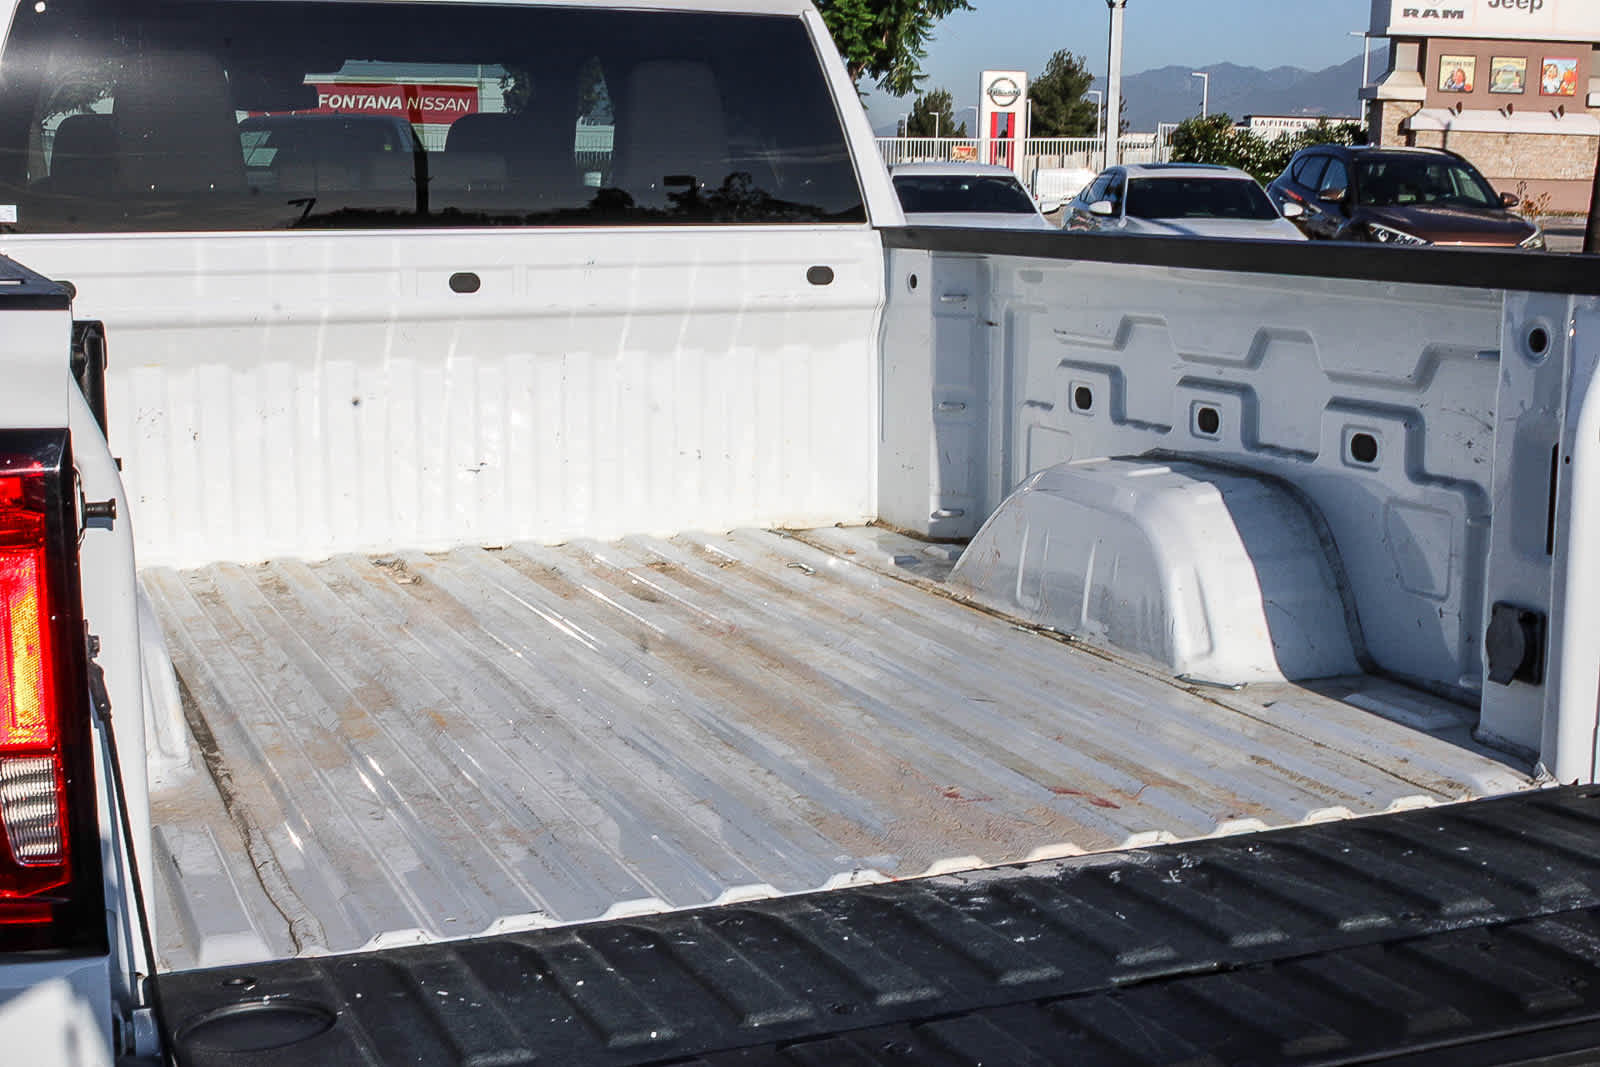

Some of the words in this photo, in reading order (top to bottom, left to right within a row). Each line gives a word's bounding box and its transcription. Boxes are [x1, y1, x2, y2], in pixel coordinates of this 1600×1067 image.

[1403, 8, 1464, 19] RAM
[319, 93, 403, 109] FONTANA
[406, 97, 470, 112] NISSAN
